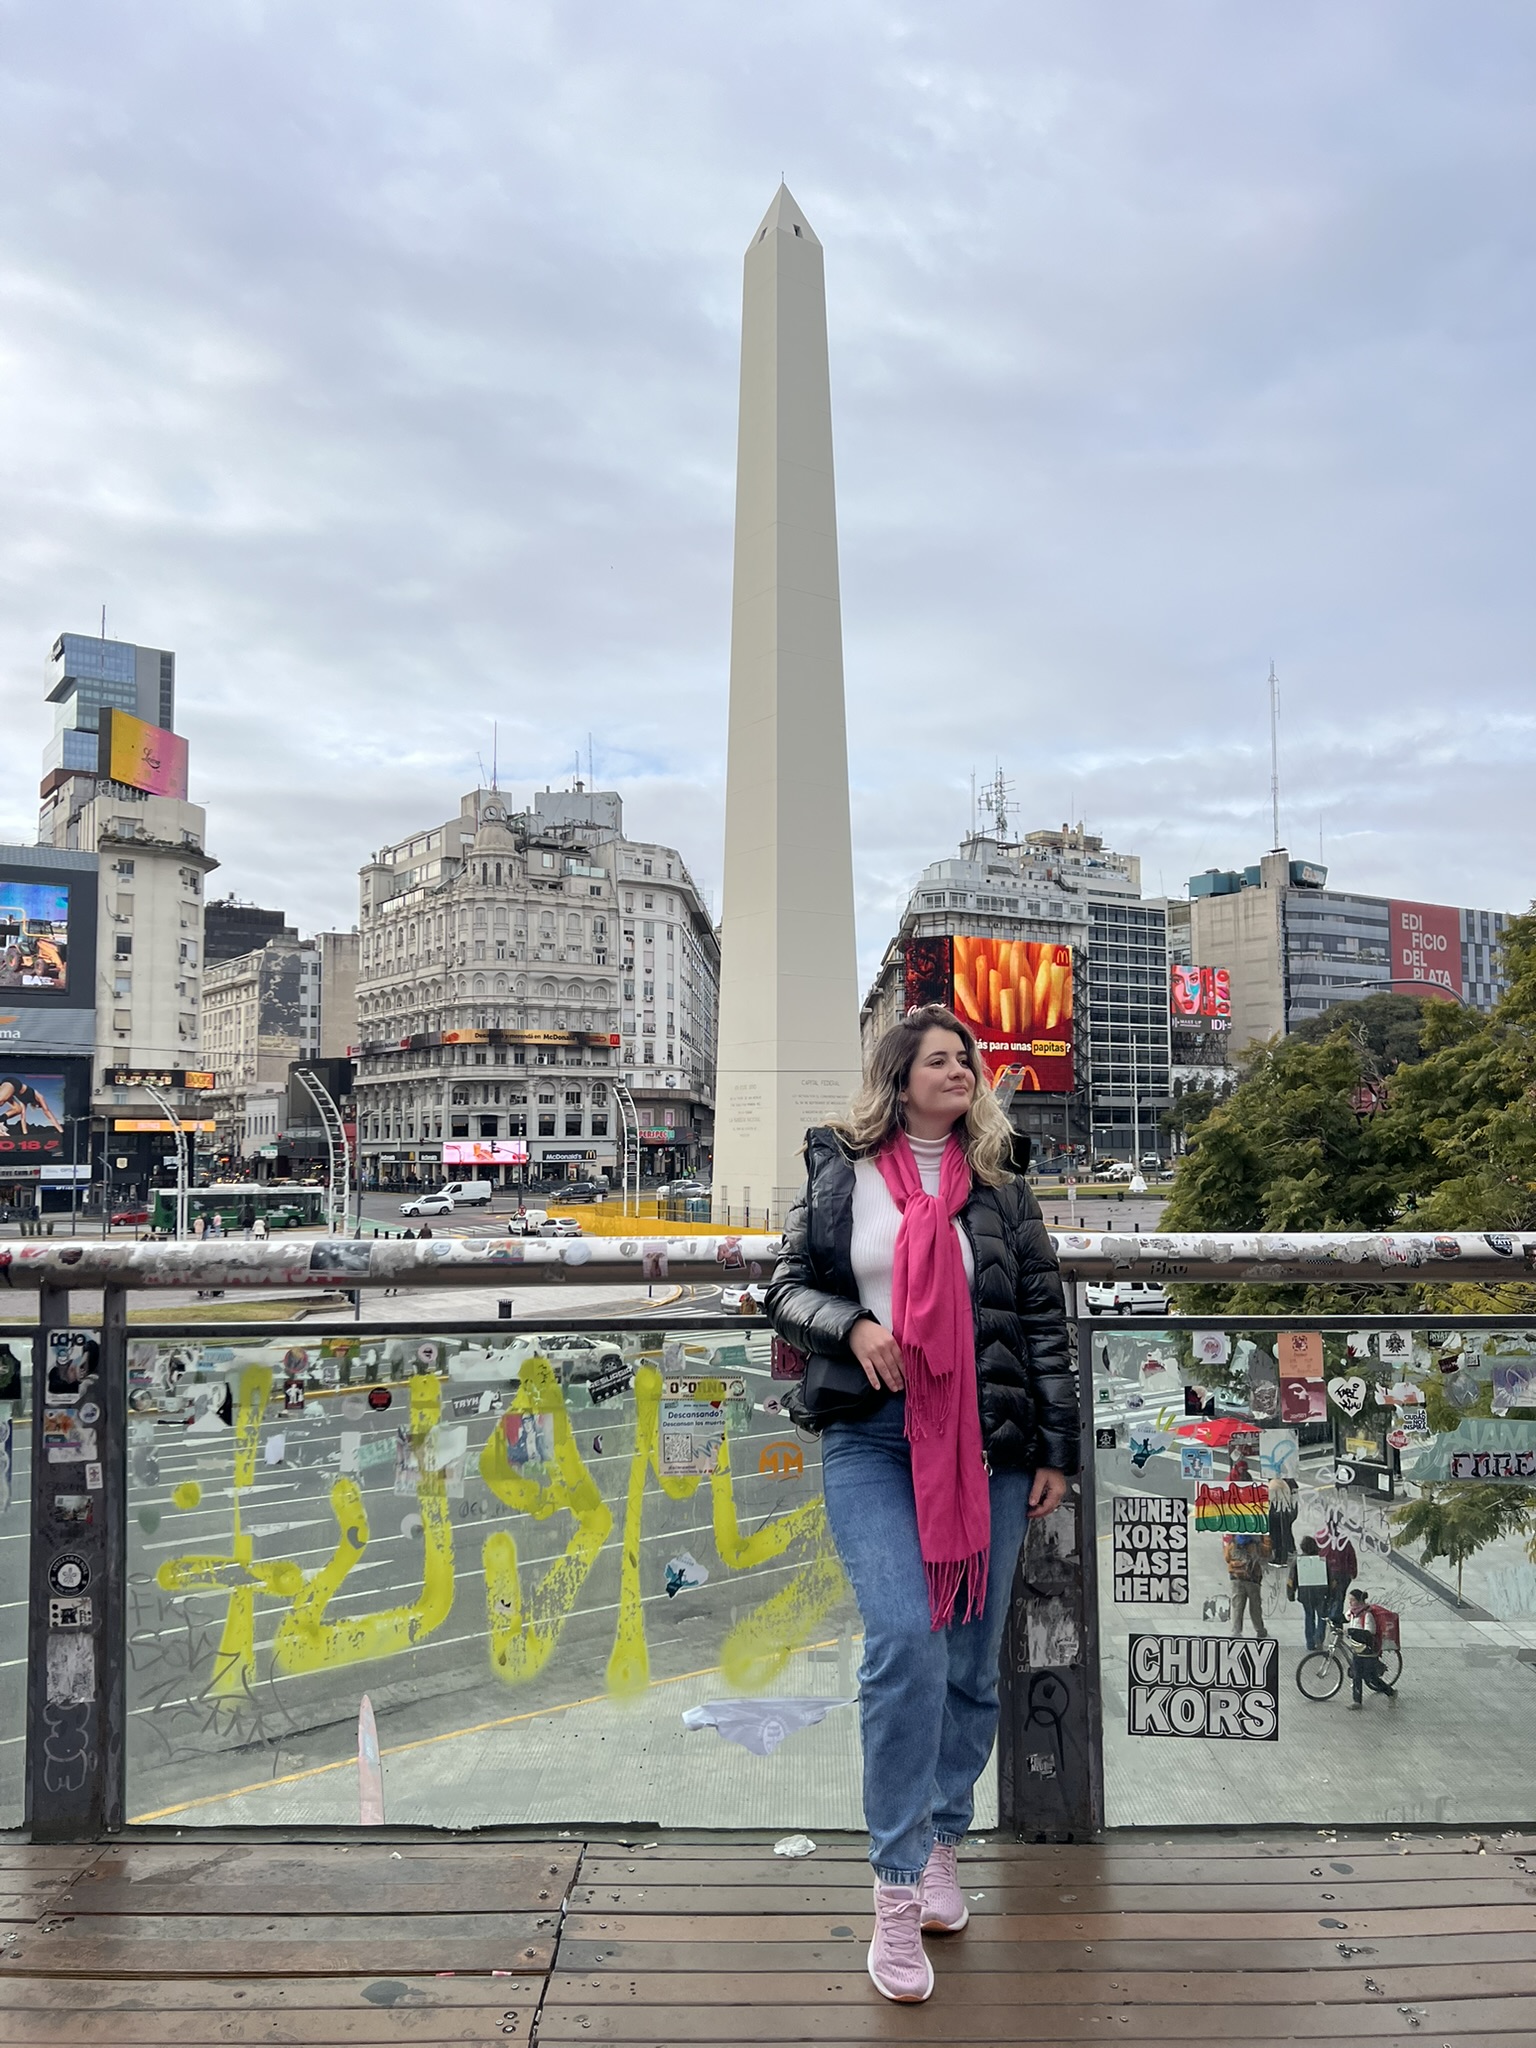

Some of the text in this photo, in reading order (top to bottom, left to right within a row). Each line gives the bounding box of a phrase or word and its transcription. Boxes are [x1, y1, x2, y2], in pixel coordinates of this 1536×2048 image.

[1401, 912, 1423, 931] EDI
[1412, 932, 1447, 952] FICIO
[1402, 948, 1428, 967] DEL
[1413, 967, 1452, 987] PLATA
[990, 1042, 1009, 1053] para
[1011, 1042, 1031, 1051] unas
[18, 1141, 41, 1151] 18
[668, 1409, 724, 1419] Descansando?
[1114, 1524, 1187, 1550] KORS
[1114, 1577, 1188, 1602] HEMS
[1131, 1636, 1275, 1688] CHUKY
[1131, 1687, 1276, 1738] KORS
